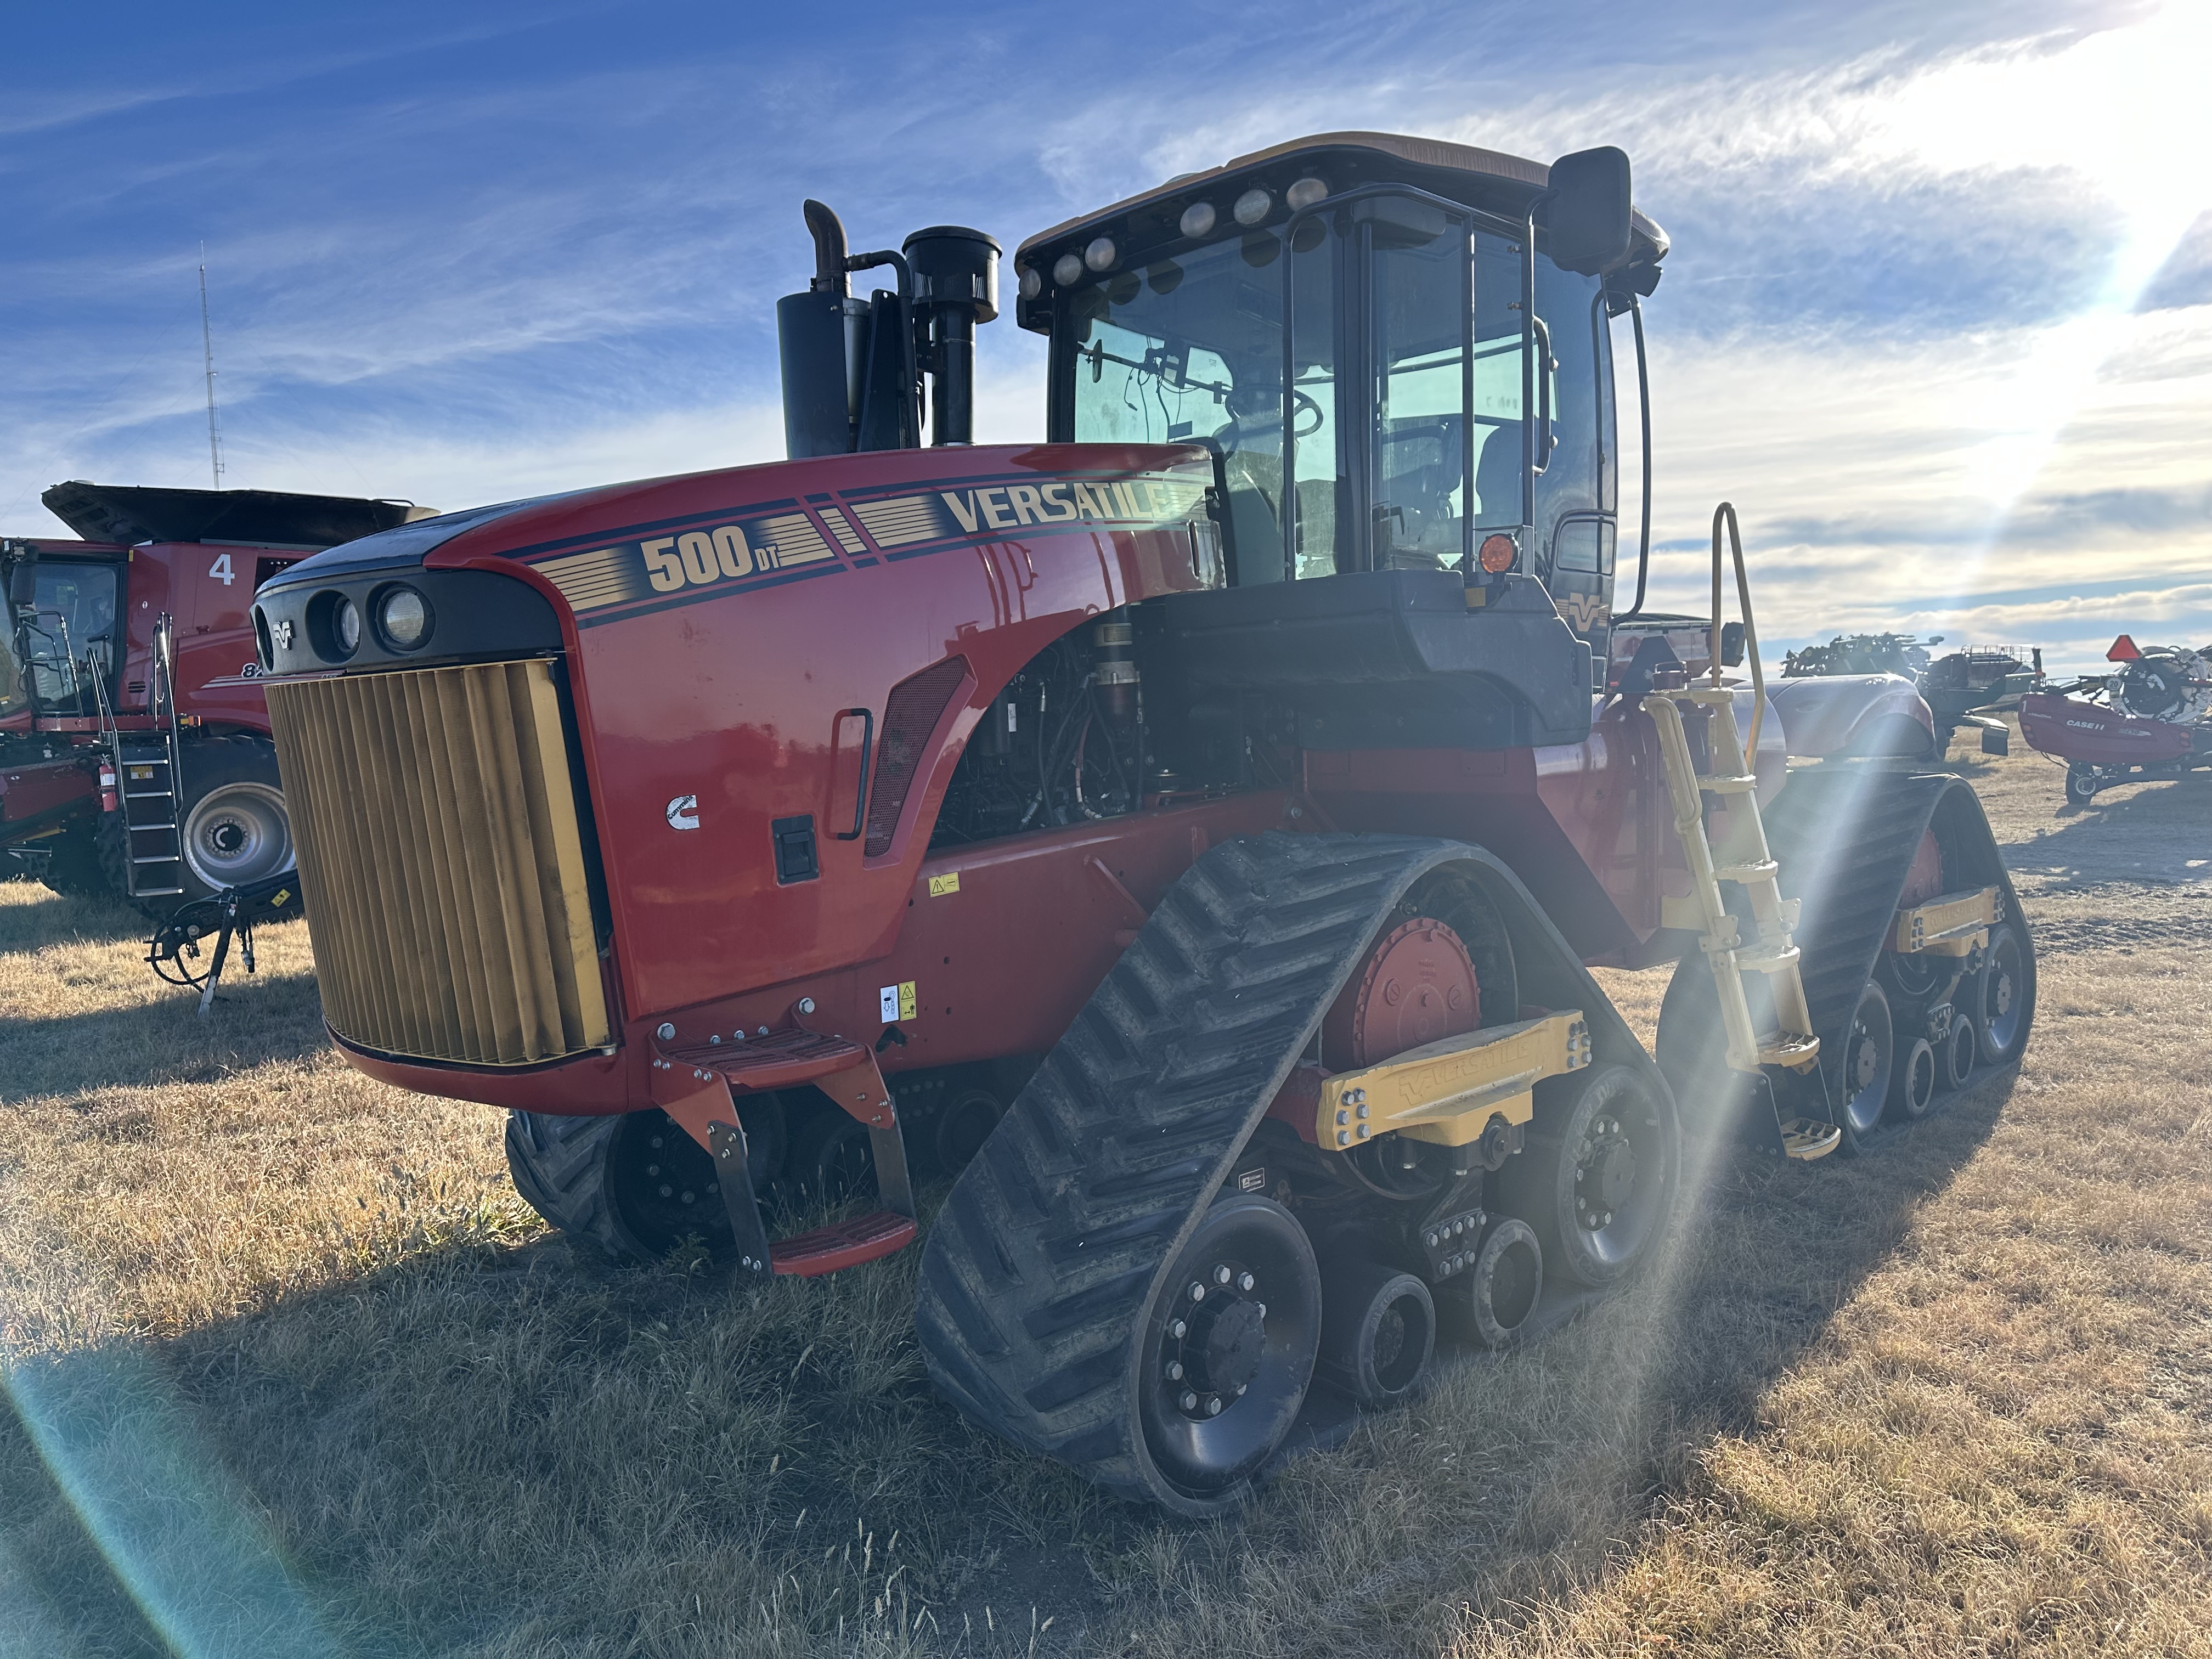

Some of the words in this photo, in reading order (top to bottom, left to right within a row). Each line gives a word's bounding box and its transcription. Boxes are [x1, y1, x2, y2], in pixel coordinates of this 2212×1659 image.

[941, 482, 1171, 533] VERSATILE
[209, 554, 235, 585] 4
[640, 525, 753, 592] 500
[754, 545, 780, 571] DT
[2022, 699, 2027, 713] 1
[2066, 720, 2095, 729] CASE
[668, 795, 693, 820] Cummins
[1431, 1041, 1528, 1085] VERSATILE
